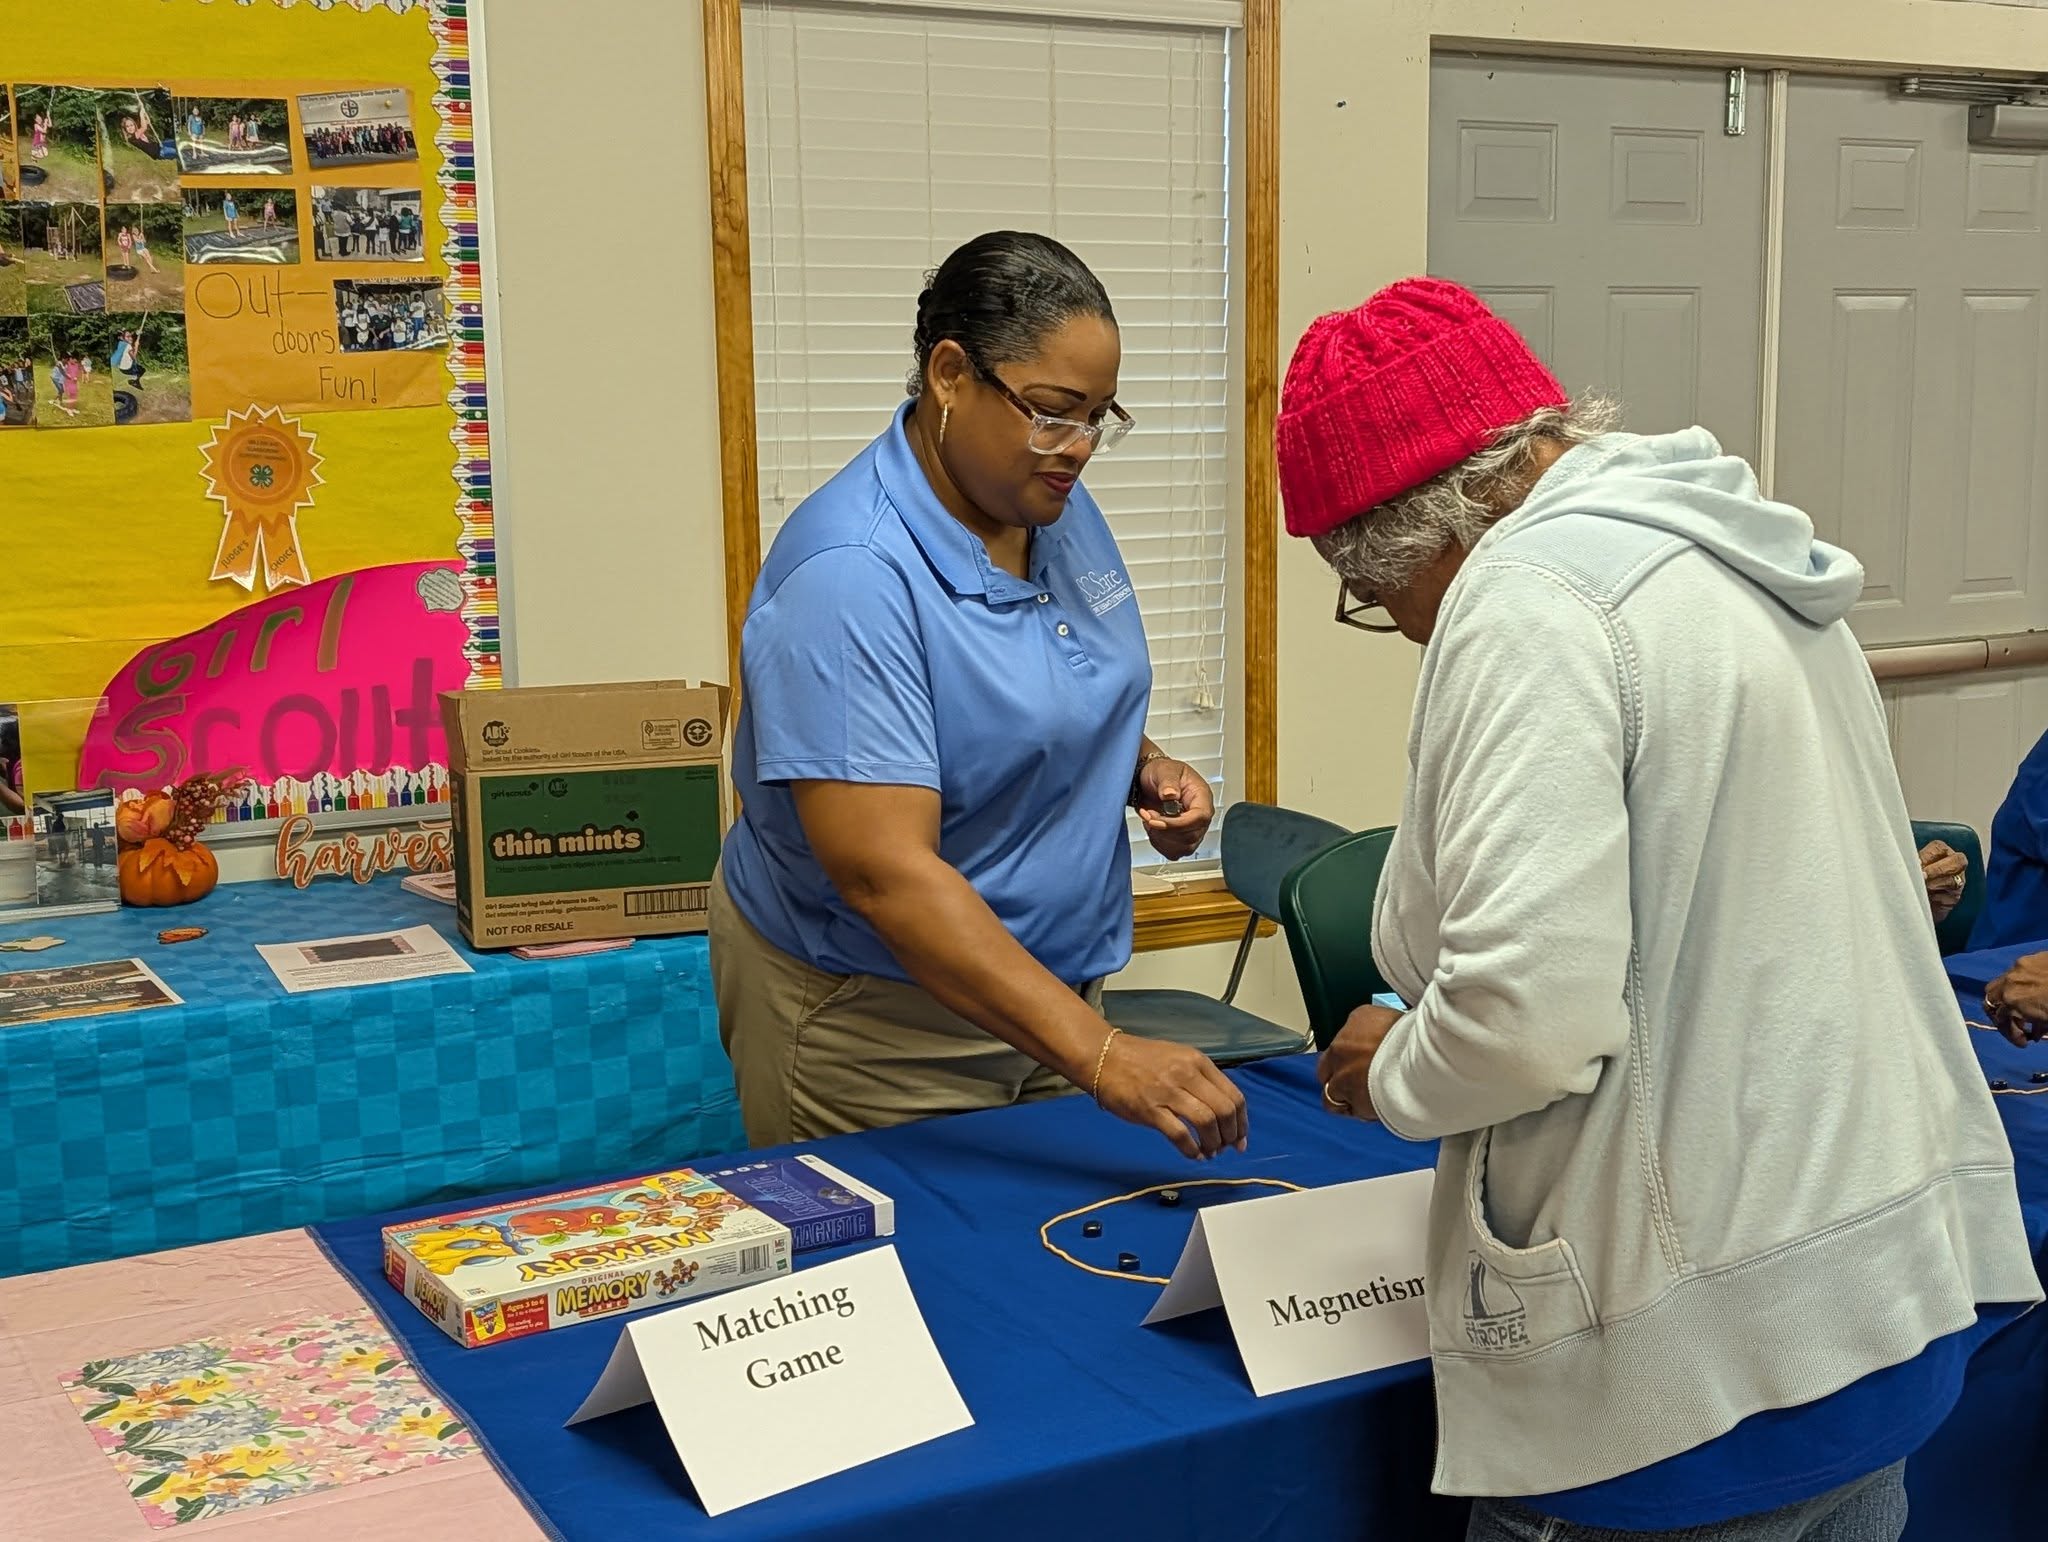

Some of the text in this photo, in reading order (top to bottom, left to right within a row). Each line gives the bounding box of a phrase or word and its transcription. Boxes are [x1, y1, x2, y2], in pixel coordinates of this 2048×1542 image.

[272, 319, 336, 354] doors
[318, 366, 377, 404] Fun!
[221, 540, 250, 568] JUDGE'S
[270, 546, 296, 571] CHOICE
[276, 813, 452, 889] harves
[493, 827, 641, 858] thin mints
[486, 921, 574, 936] NOT FOR RESALE
[517, 1231, 715, 1282] MEMORY
[556, 1270, 650, 1316] MEMORY
[581, 1271, 625, 1285] ORIGINAL
[507, 1304, 525, 1312] Ages
[693, 1286, 856, 1351] Matching
[746, 1344, 845, 1389] Game
